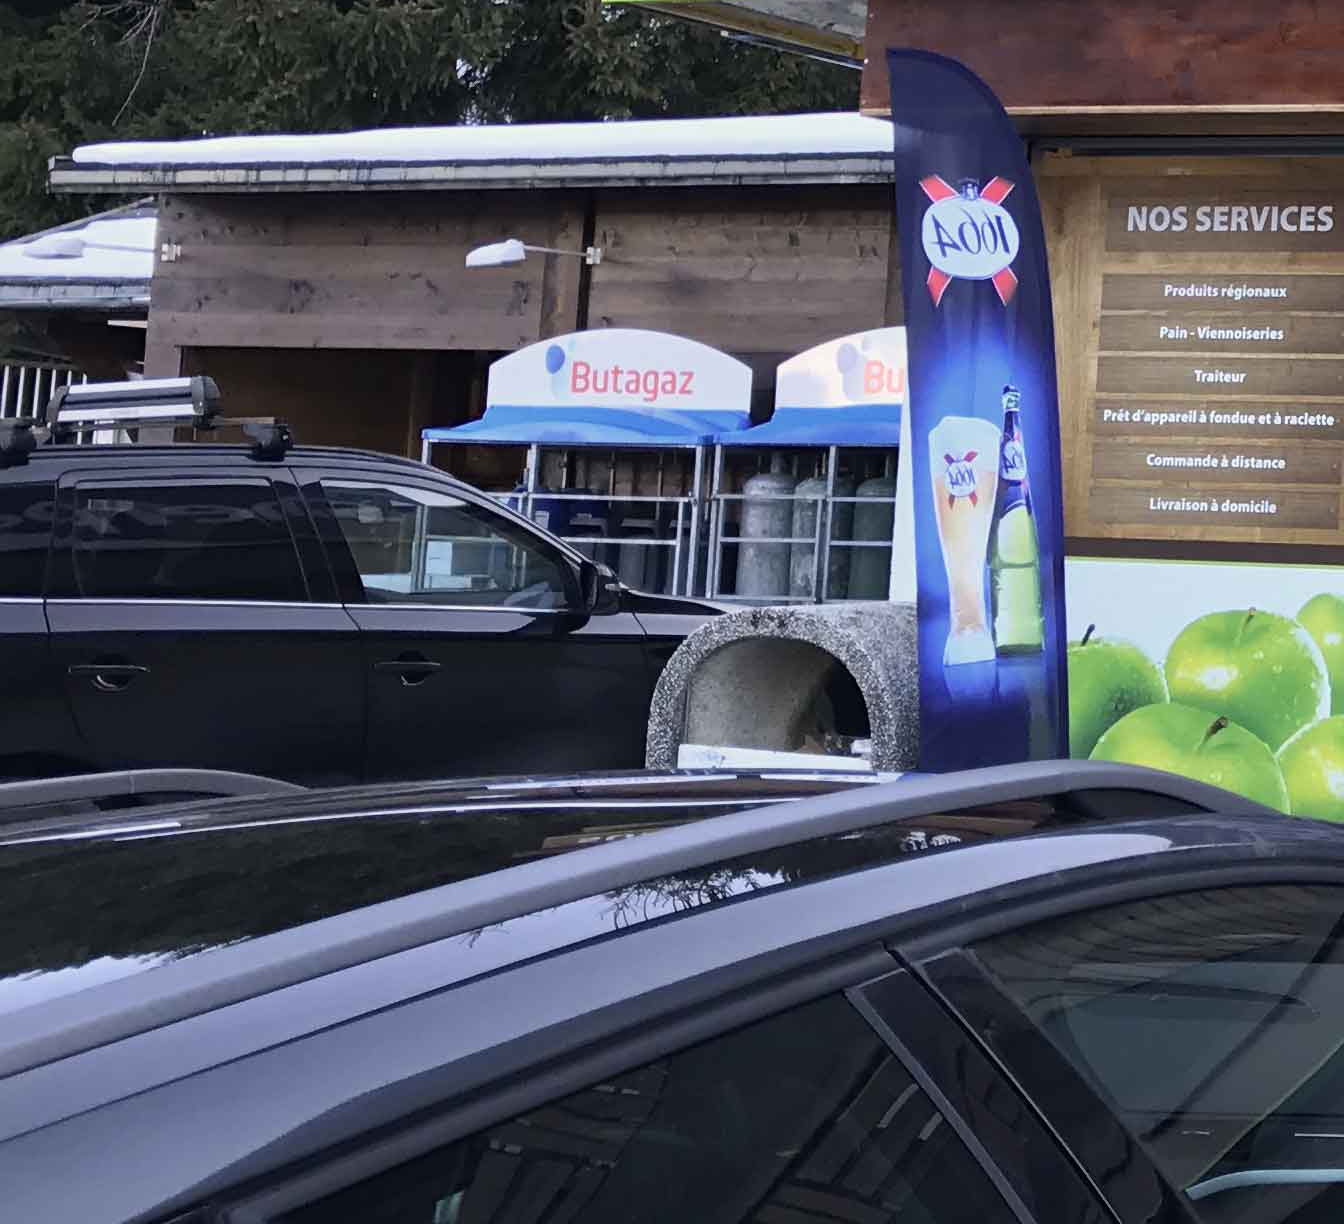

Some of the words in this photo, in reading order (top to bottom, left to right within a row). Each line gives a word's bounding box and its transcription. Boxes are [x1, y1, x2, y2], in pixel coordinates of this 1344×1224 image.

[1127, 206, 1188, 233] NOS
[1195, 206, 1334, 233] SERVICES
[1164, 284, 1218, 297] Produits
[1221, 284, 1287, 301] régionaux
[1160, 326, 1188, 340] Pain
[1198, 326, 1284, 340] Viennoiseries
[570, 361, 695, 402] Butagaz
[1194, 369, 1247, 383] Traiteur
[1103, 409, 1130, 422] Prêt
[1132, 409, 1197, 425] d'appareil
[1199, 410, 1207, 424] à
[1209, 410, 1256, 425] fondue
[1258, 414, 1272, 425] et
[1274, 412, 1282, 425] à
[1285, 413, 1335, 426] raclette
[1146, 454, 1218, 468] Commande
[1220, 455, 1228, 468] à
[1231, 455, 1286, 469] distance
[1150, 498, 1207, 512] Livraison
[1210, 498, 1219, 512] à
[1221, 499, 1277, 514] domicile
